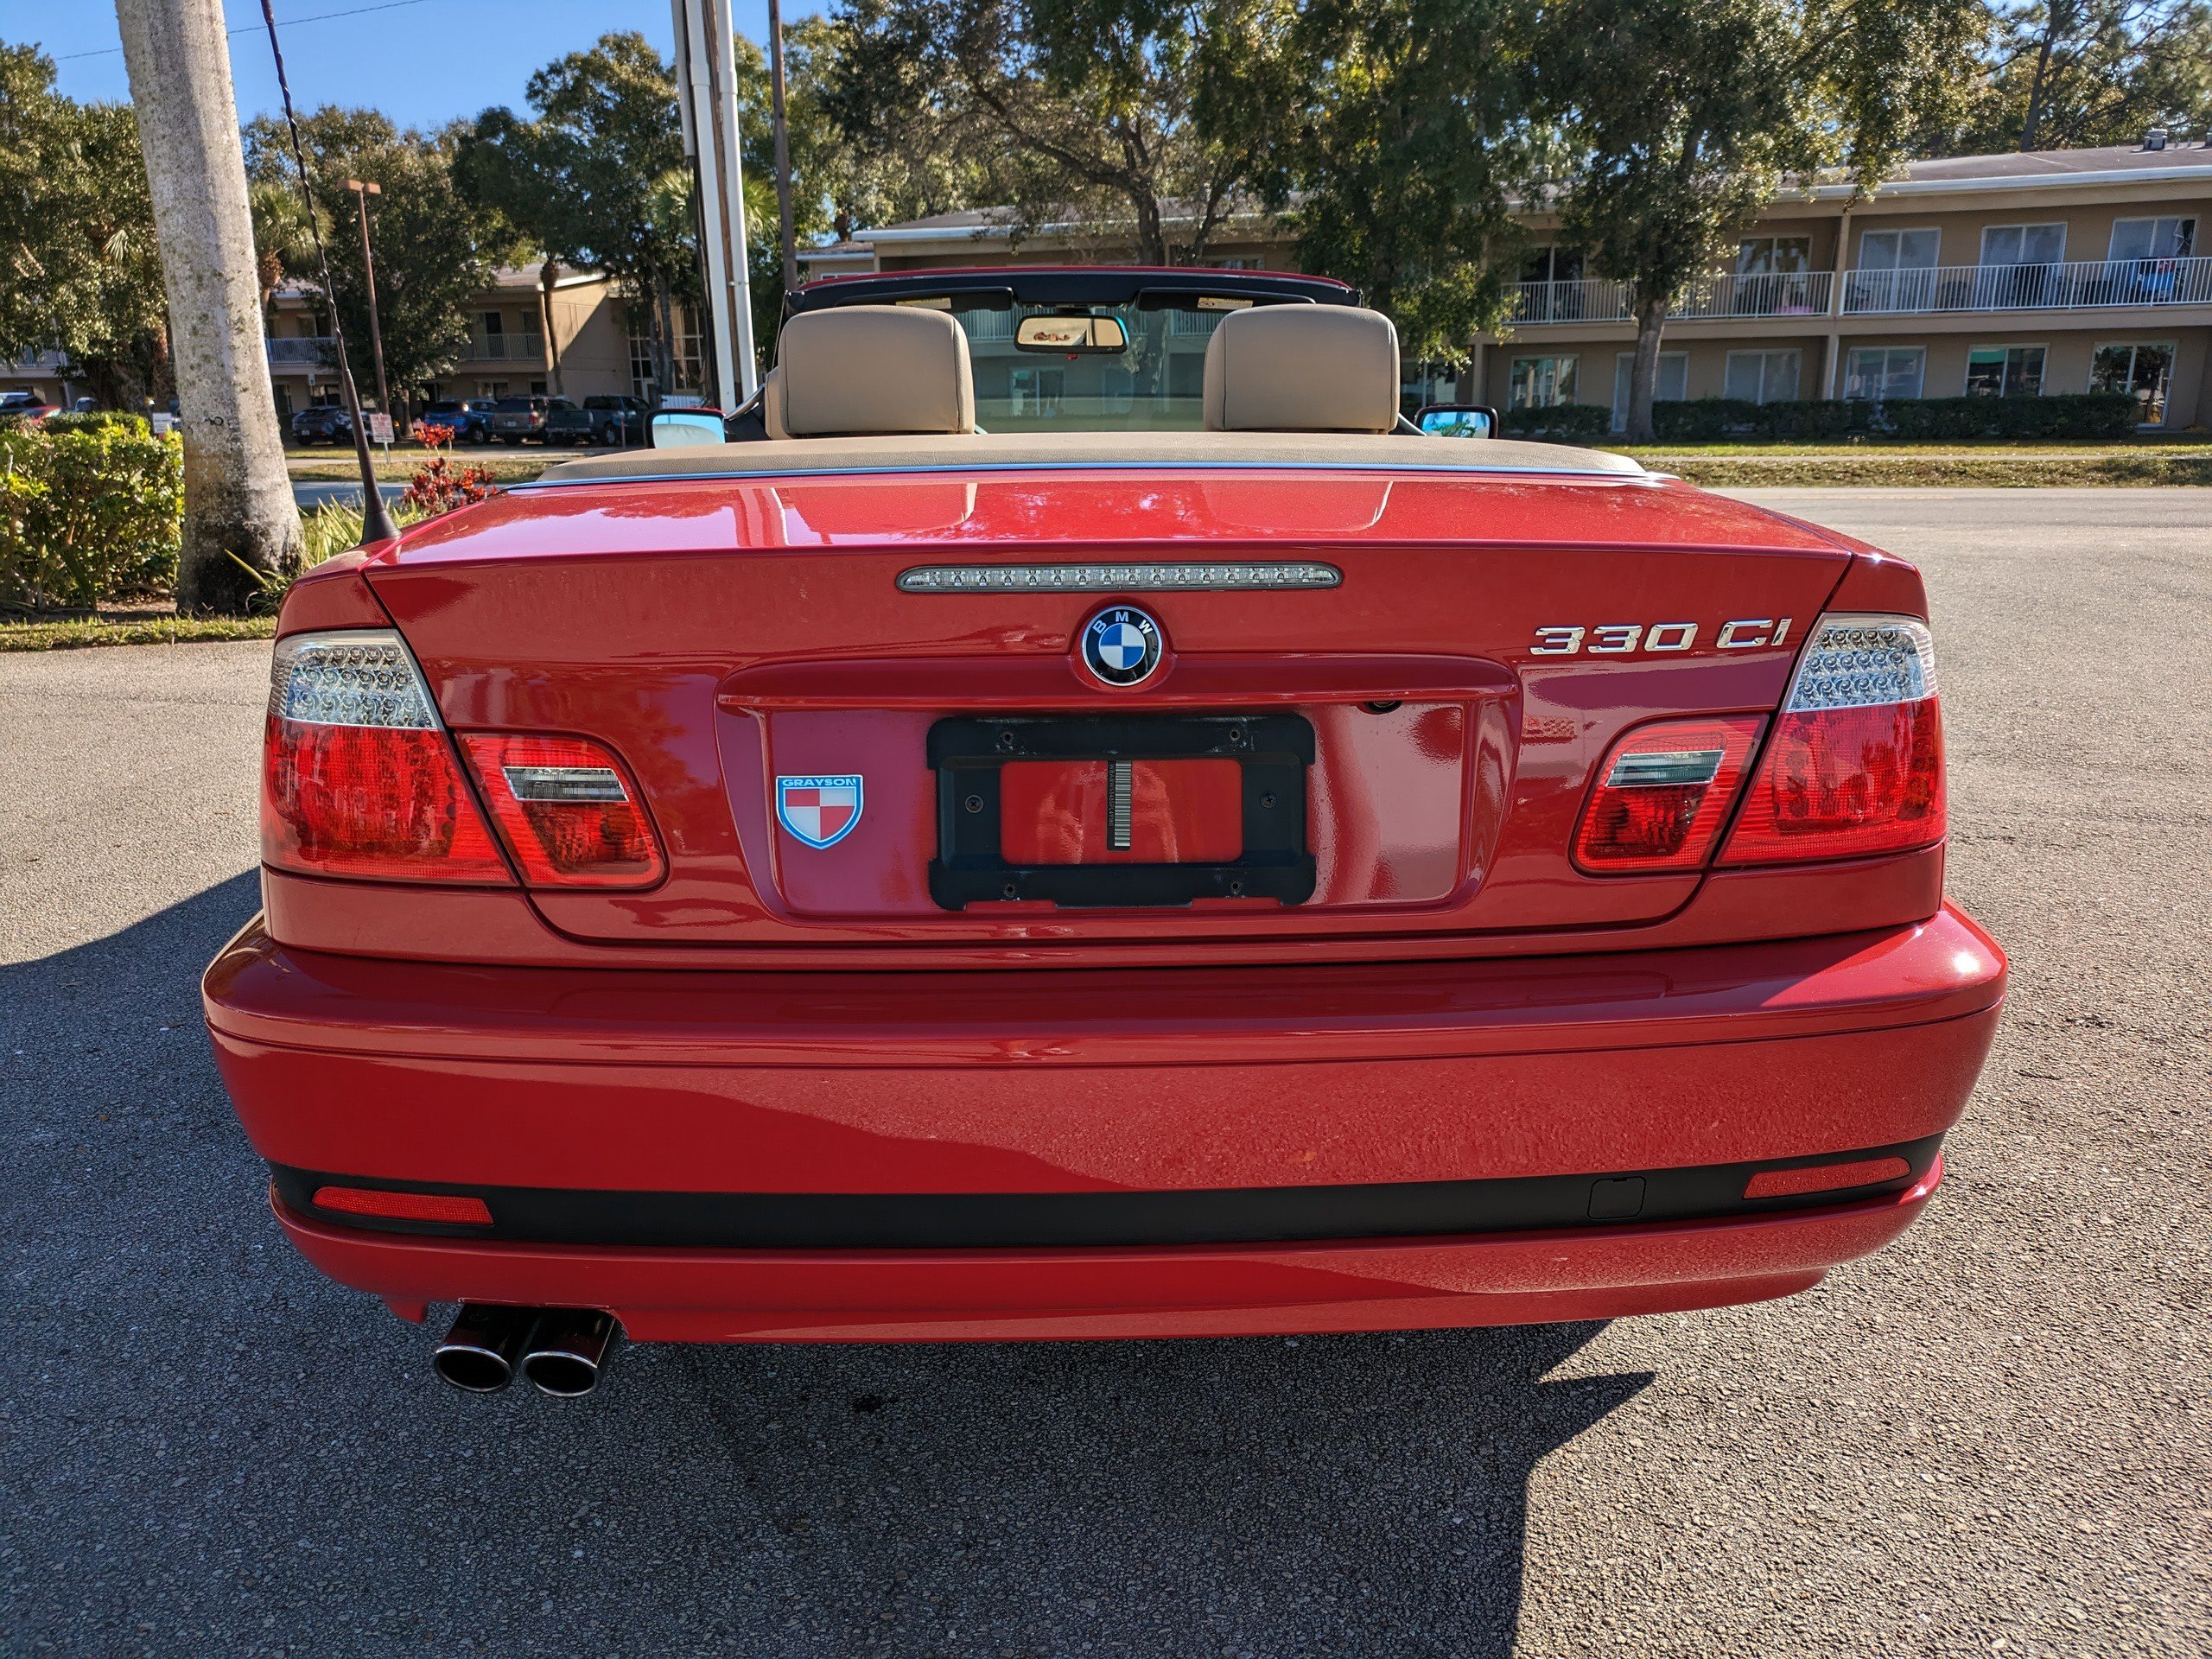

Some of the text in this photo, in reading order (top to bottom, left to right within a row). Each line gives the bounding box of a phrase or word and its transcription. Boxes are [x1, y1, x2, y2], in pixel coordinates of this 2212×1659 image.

[1092, 611, 1154, 634] BMW
[1529, 622, 1699, 655] 330
[782, 779, 856, 787] GRAYSON
